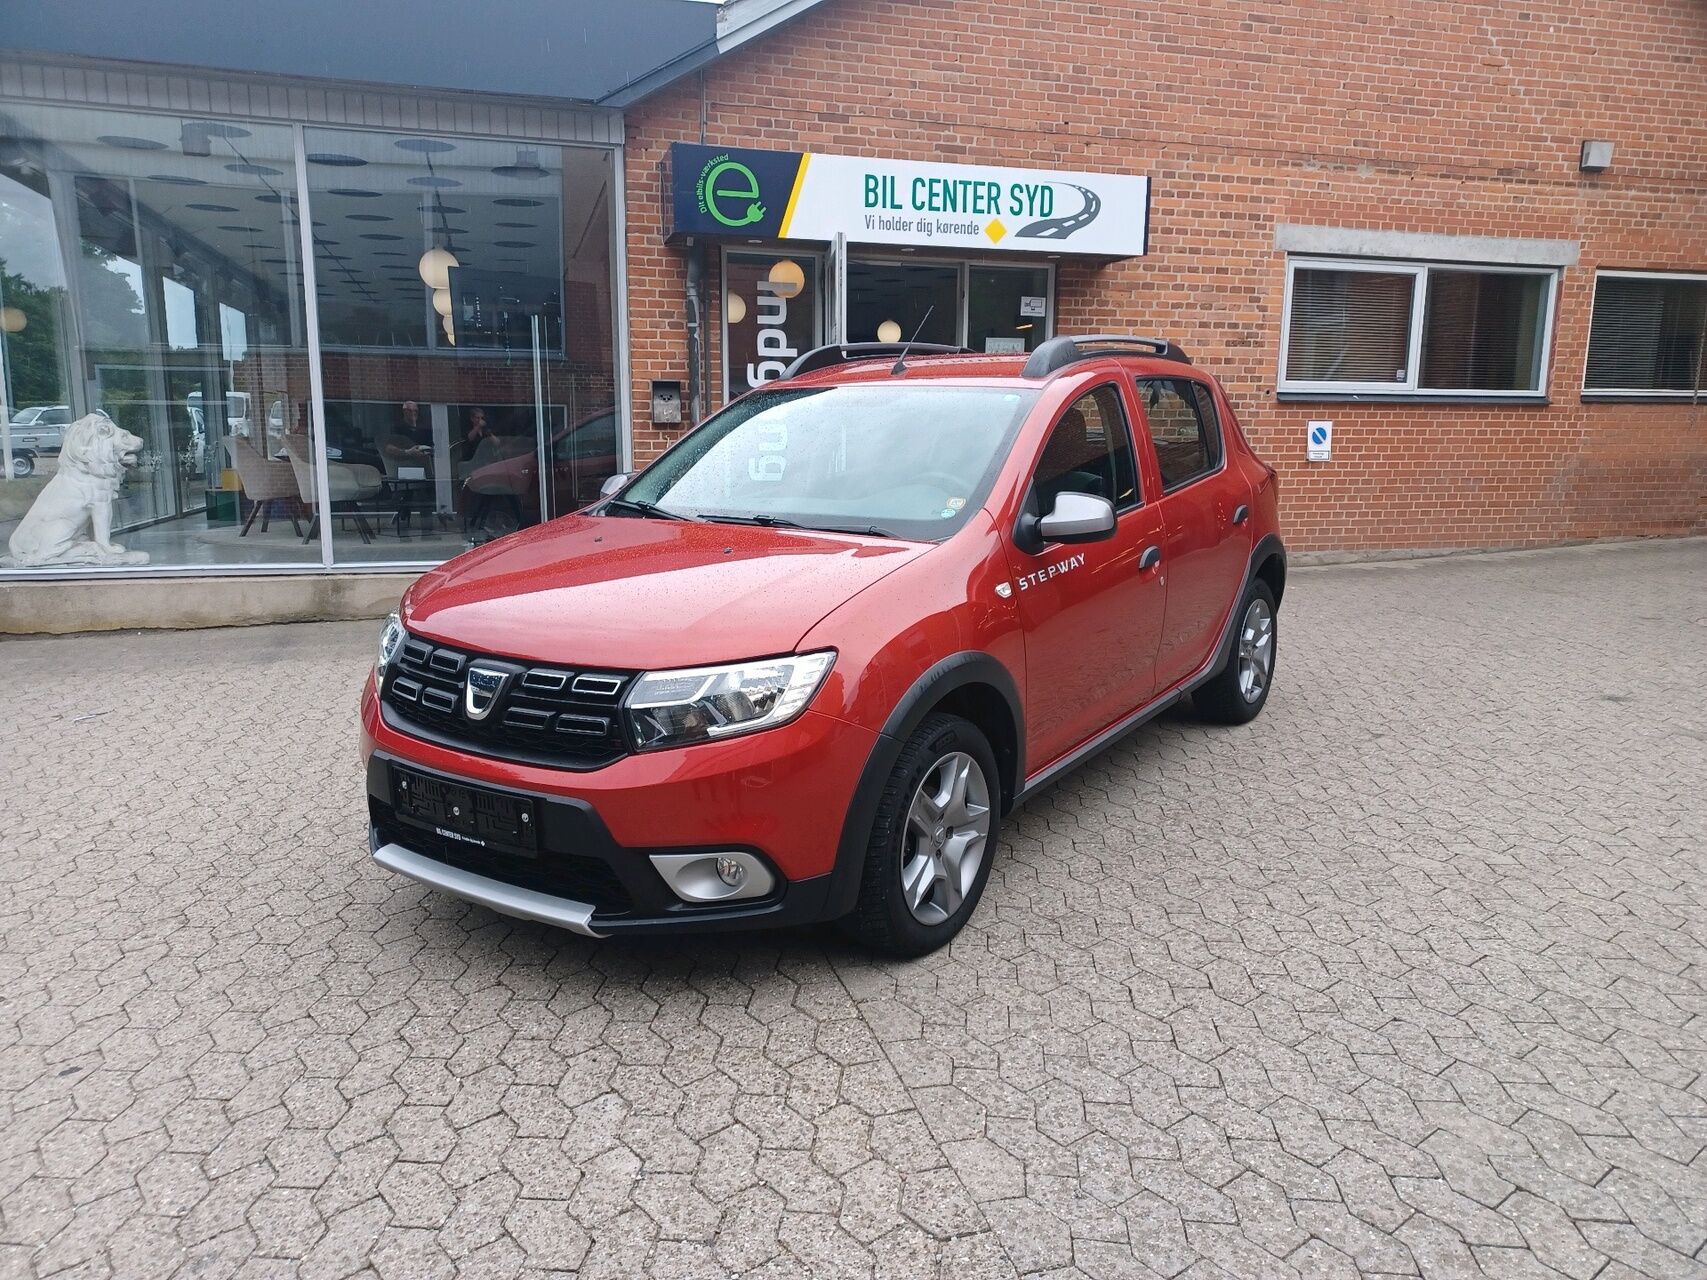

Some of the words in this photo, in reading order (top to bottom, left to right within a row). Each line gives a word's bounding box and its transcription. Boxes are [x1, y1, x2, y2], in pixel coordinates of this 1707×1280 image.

[864, 174, 903, 210] BIL
[911, 177, 1001, 215] CENTER
[1009, 183, 1054, 218] SYD
[864, 214, 875, 230] Vi
[878, 215, 914, 232] holder
[916, 218, 933, 237] dig
[936, 219, 980, 236] kørende
[1018, 552, 1086, 591] STEPWAY
